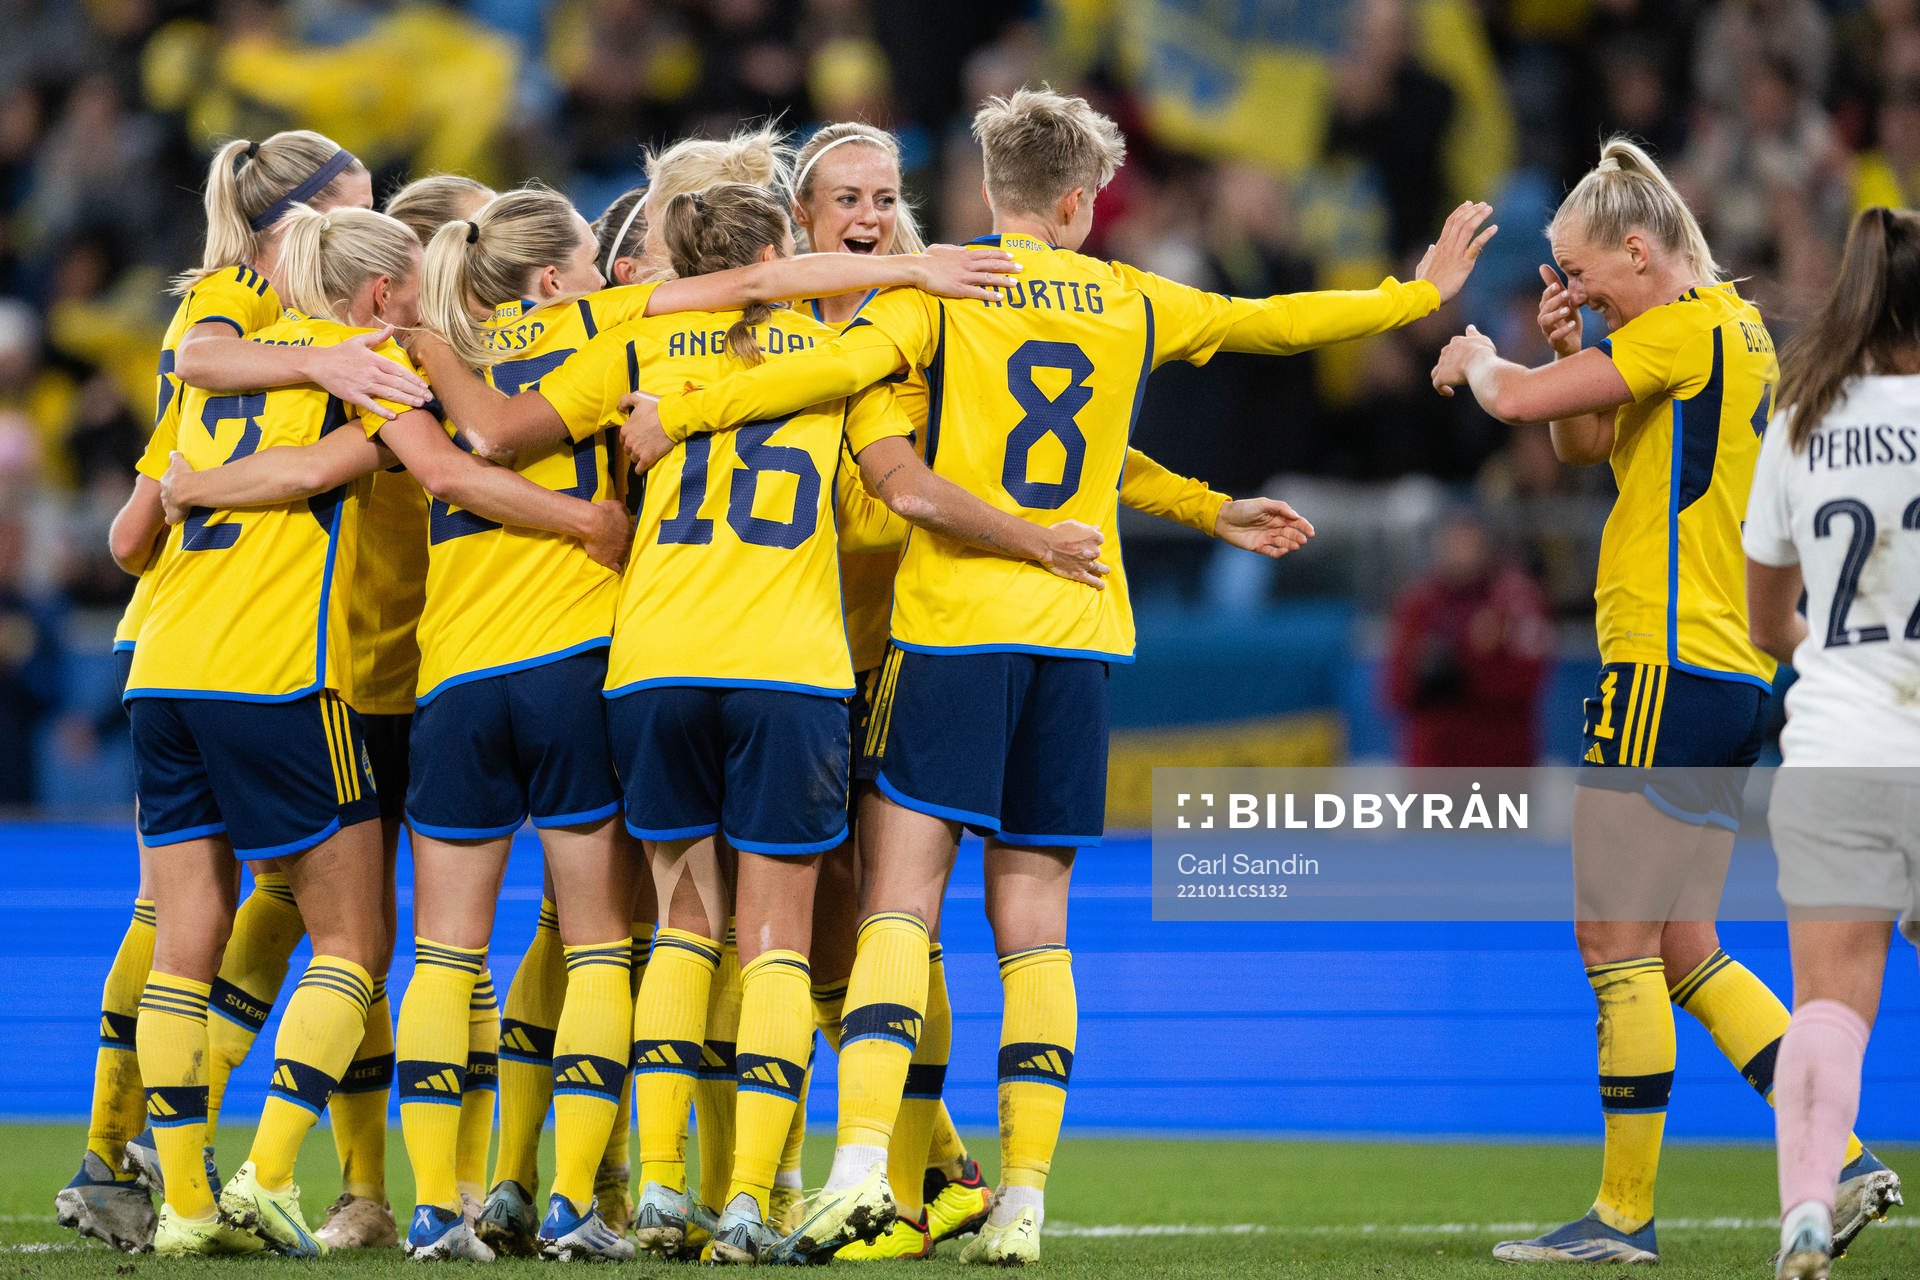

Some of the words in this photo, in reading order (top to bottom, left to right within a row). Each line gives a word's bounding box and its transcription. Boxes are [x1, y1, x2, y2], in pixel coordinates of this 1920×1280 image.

[669, 327, 814, 357] ANGLDA
[1001, 339, 1095, 509] 8
[1809, 424, 1919, 474] PERISS
[657, 415, 822, 550] 16
[1814, 496, 1920, 648] 2
[1584, 671, 1618, 740] 1
